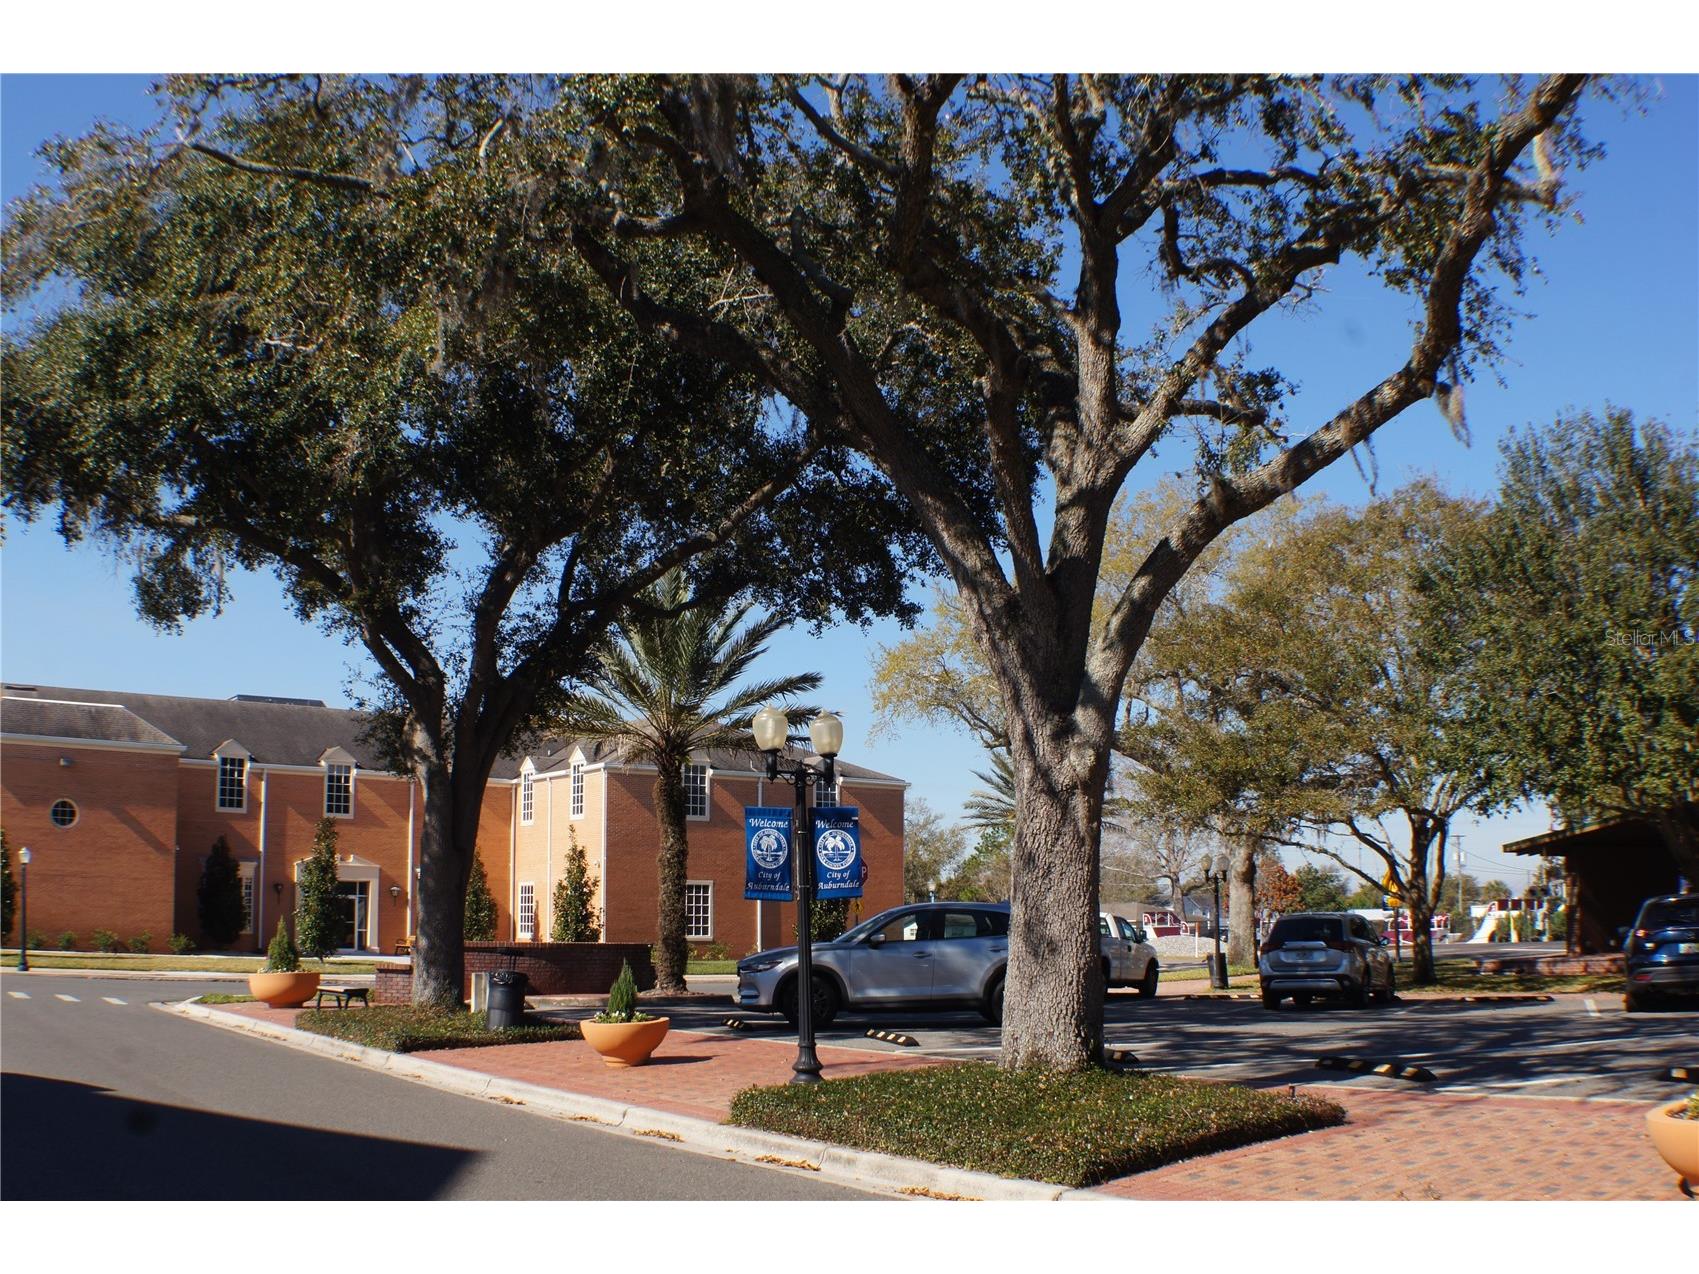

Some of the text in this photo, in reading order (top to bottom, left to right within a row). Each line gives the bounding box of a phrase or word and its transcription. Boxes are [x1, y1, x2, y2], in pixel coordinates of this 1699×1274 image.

[749, 818, 789, 828] Welcome
[815, 819, 854, 829] Welcome
[758, 871, 781, 881] City of
[826, 871, 841, 880] City
[842, 870, 850, 880] of
[747, 882, 790, 891] Auburndale
[817, 880, 860, 890] Auburndale
